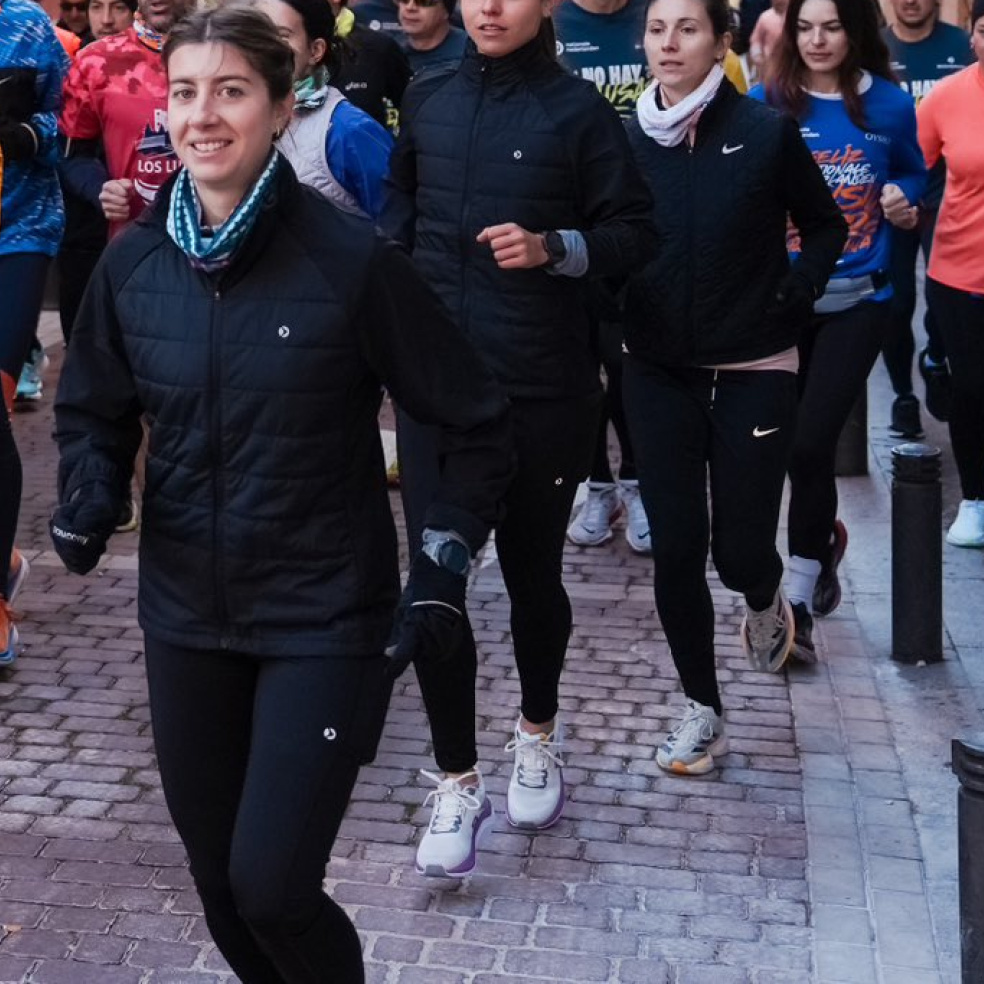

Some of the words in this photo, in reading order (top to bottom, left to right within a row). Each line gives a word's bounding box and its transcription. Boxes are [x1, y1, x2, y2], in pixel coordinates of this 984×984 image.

[581, 66, 607, 86] NO
[608, 64, 643, 86] HAY
[137, 159, 163, 174] LOS
